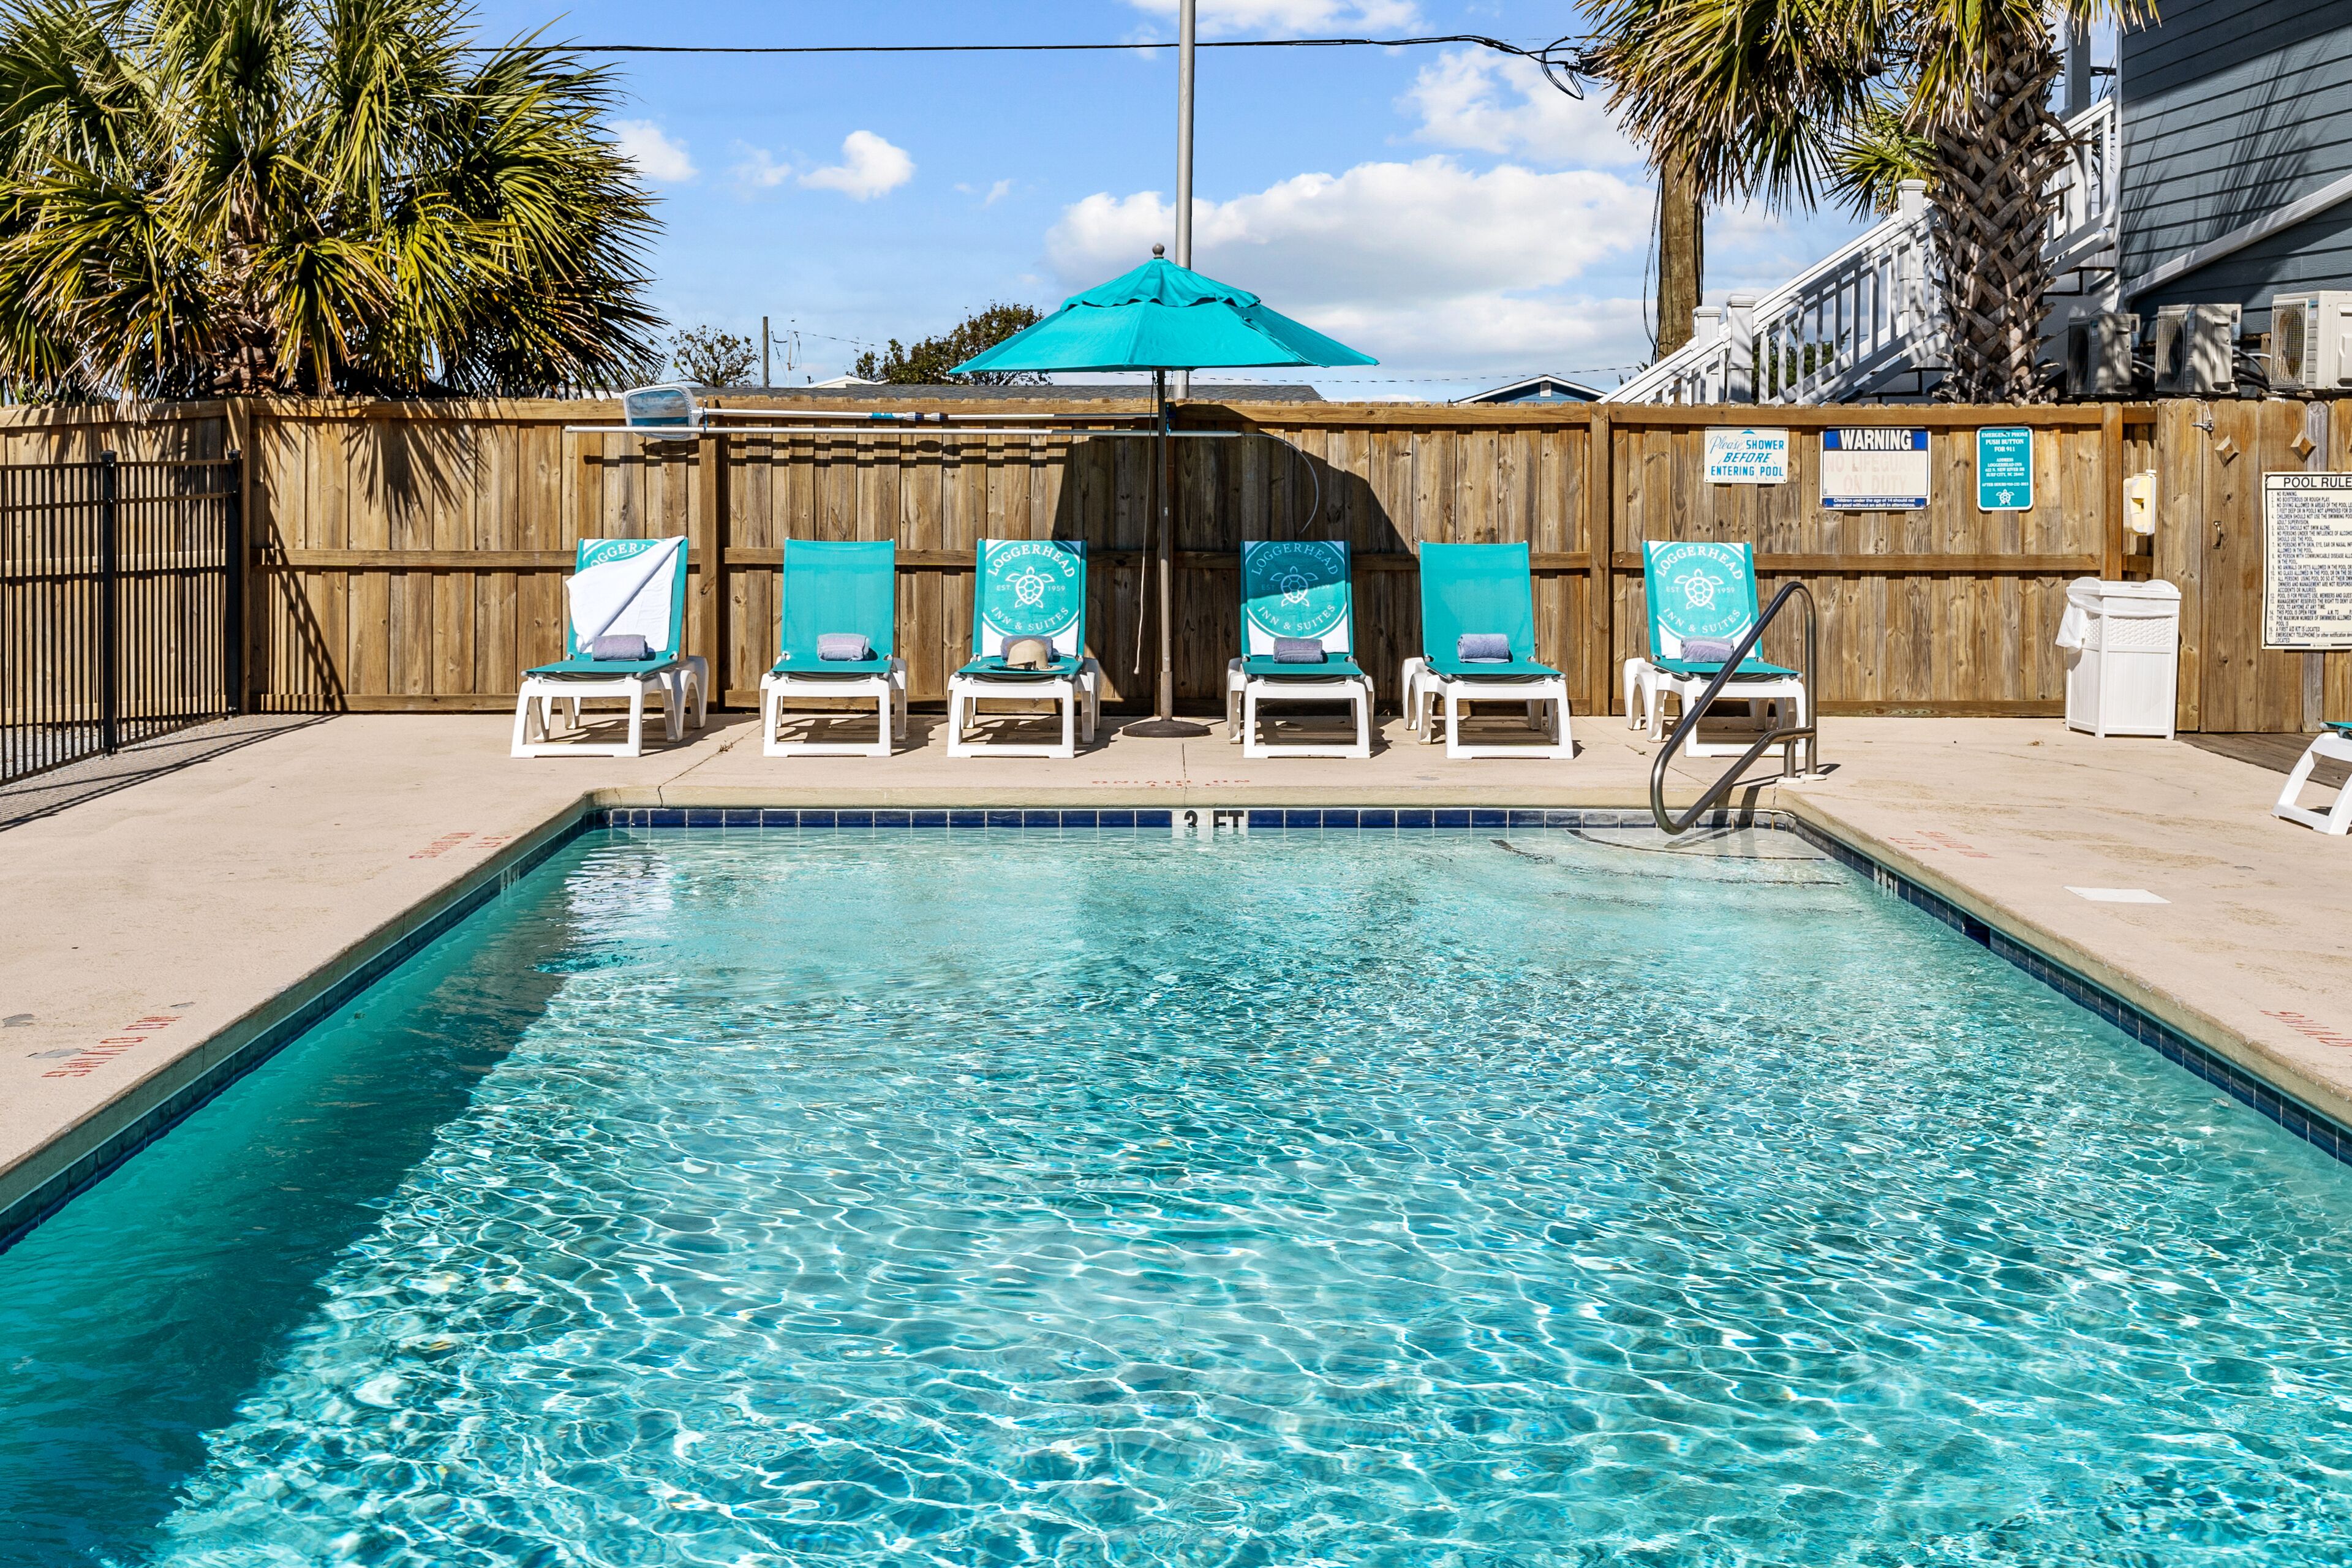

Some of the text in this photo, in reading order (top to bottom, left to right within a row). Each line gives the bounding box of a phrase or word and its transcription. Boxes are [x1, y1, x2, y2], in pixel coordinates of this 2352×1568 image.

[1710, 434, 1784, 454] Please SHOWER
[1840, 429, 1912, 450] WARNING
[1723, 452, 1772, 463] BEFORE
[1825, 453, 1845, 472] NO
[1711, 466, 1784, 476] ENTERING POOL
[1844, 475, 1907, 494] ON DUTY
[2284, 477, 2352, 488] POOL RULE
[987, 544, 1075, 577] LOGGERHEAD
[1251, 543, 1338, 576] LOGGERHEAD
[1656, 546, 1743, 579] LOGGERHEAD
[991, 606, 1069, 631] INN & SUITES
[1258, 605, 1335, 631] INN & SUITES
[1664, 608, 1746, 633] INN & SUITES
[1184, 810, 1245, 828] 3 FT
[41, 1036, 149, 1078] DIVING
